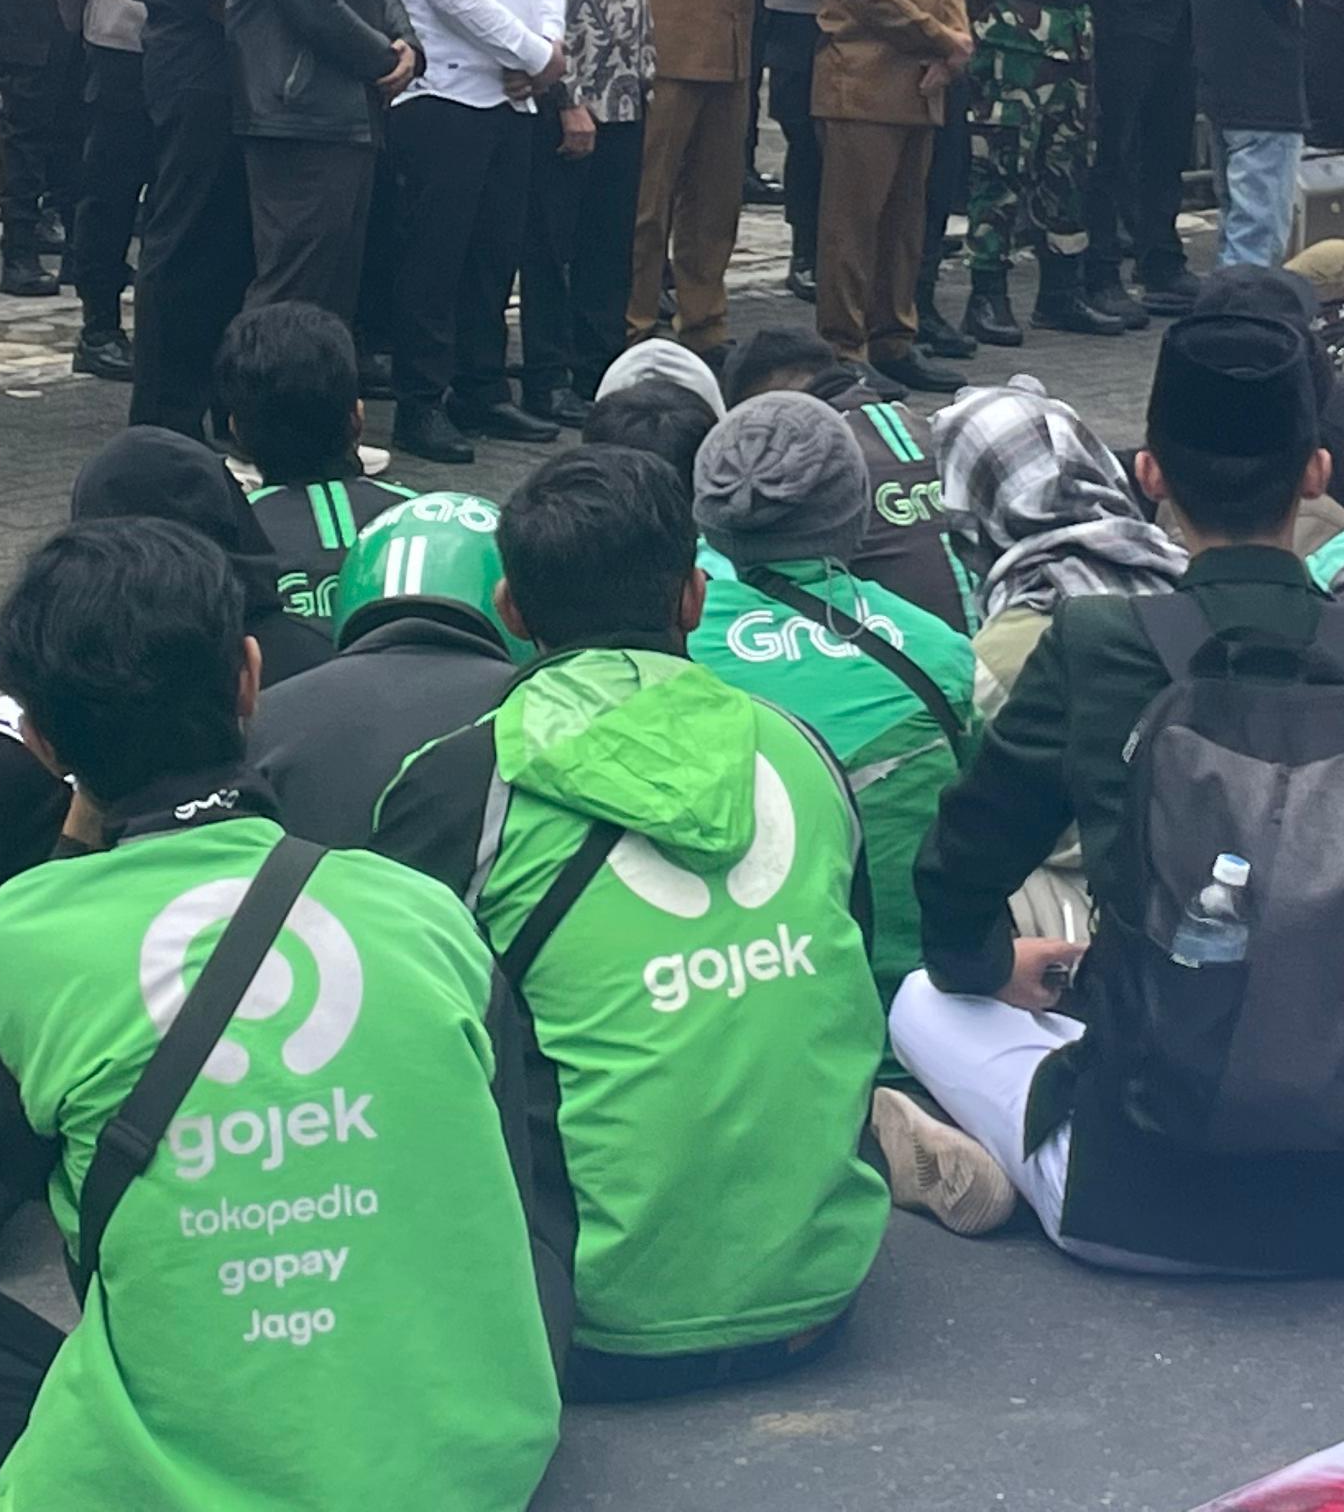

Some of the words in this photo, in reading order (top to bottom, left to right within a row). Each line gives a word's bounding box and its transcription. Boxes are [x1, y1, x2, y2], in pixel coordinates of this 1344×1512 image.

[875, 481, 946, 525] Gr
[643, 923, 817, 1013] gojek
[169, 1087, 378, 1182] gojek
[180, 1183, 378, 1237] tokopedia
[218, 1247, 350, 1296] gopay
